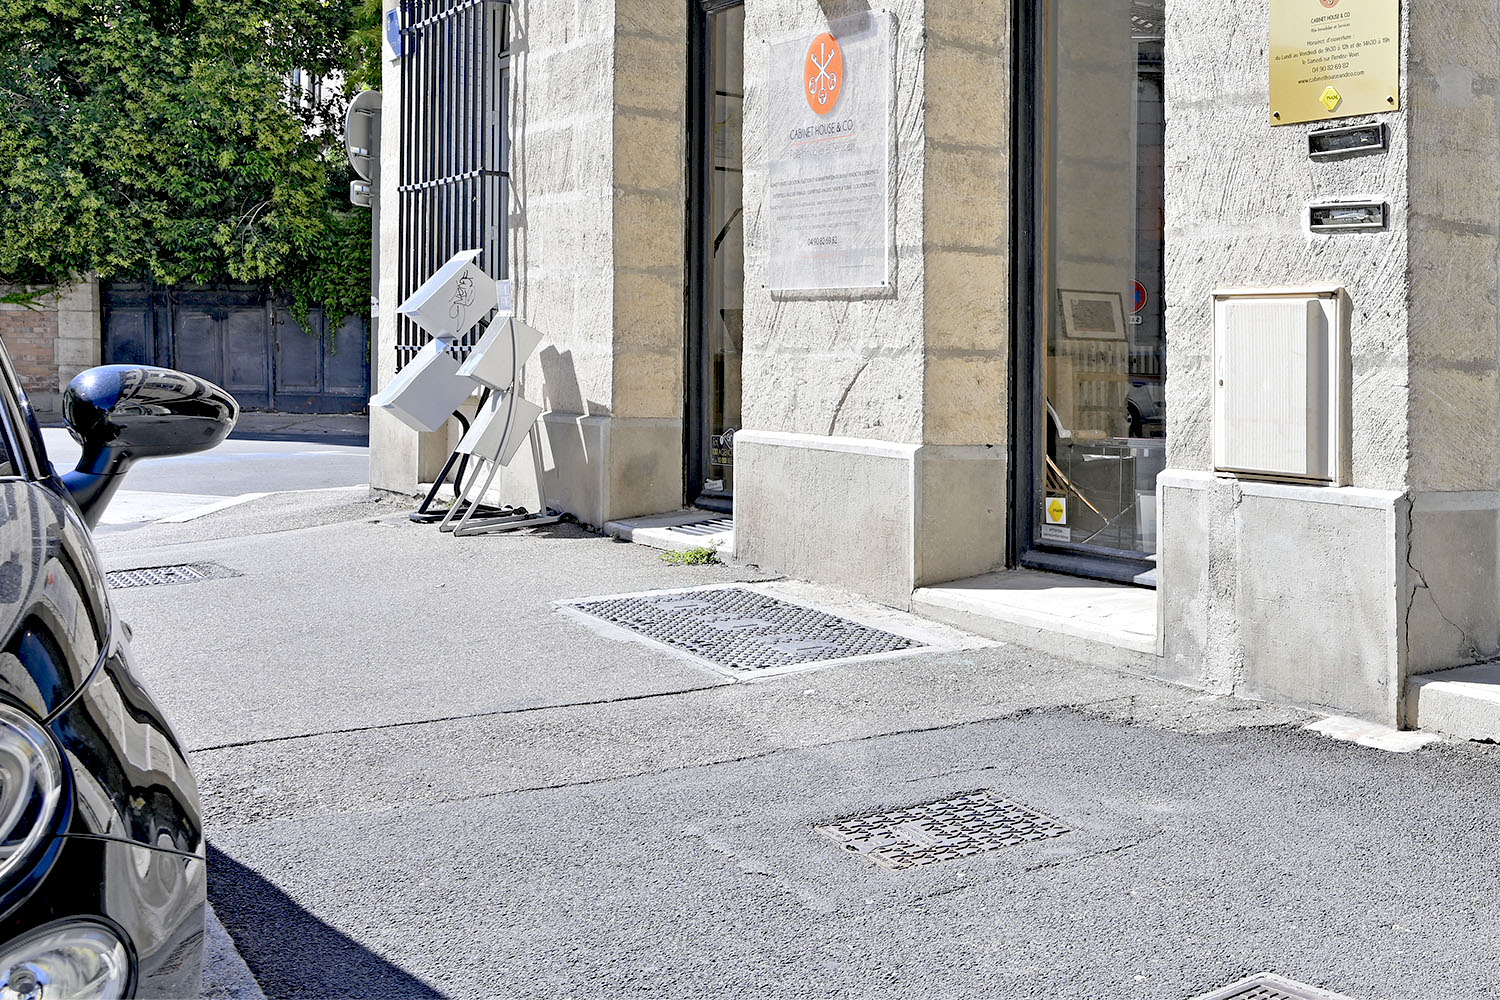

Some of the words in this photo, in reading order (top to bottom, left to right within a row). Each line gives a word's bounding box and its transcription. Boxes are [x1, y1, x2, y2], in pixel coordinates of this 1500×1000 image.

[1311, 16, 1327, 24] CABINET
[1327, 13, 1340, 21] HOUSE
[789, 126, 814, 140] CABINET
[815, 122, 836, 136] HOUSE
[842, 119, 854, 131] CO
